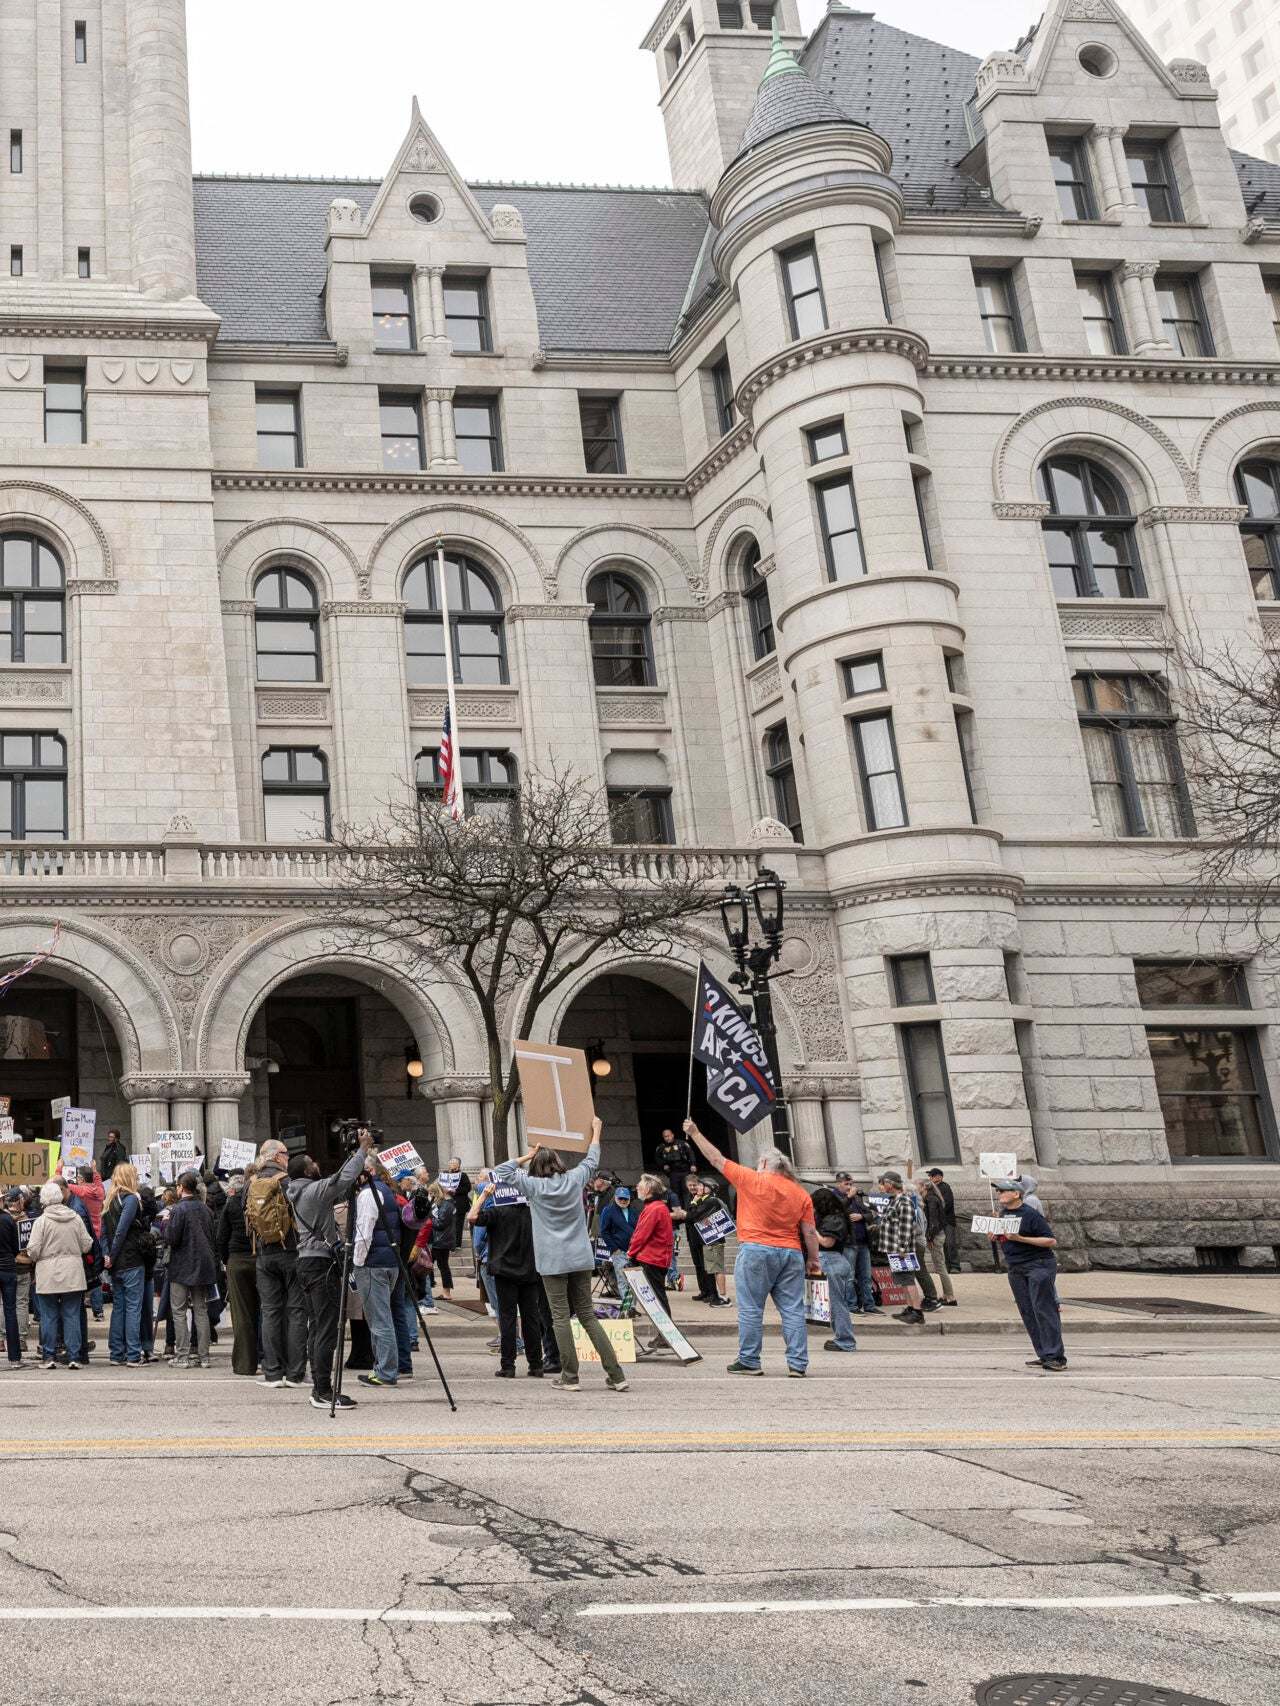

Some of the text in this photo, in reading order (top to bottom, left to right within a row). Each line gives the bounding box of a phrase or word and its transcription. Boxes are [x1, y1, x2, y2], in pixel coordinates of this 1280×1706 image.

[712, 1004, 768, 1067] KINGS
[169, 1132, 192, 1140] PROCESS
[170, 1150, 193, 1159] PROCESS
[379, 1142, 414, 1162] ENFORCE
[21, 1149, 49, 1178] UP!
[394, 1155, 408, 1164] OUR
[21, 1222, 32, 1231] NO
